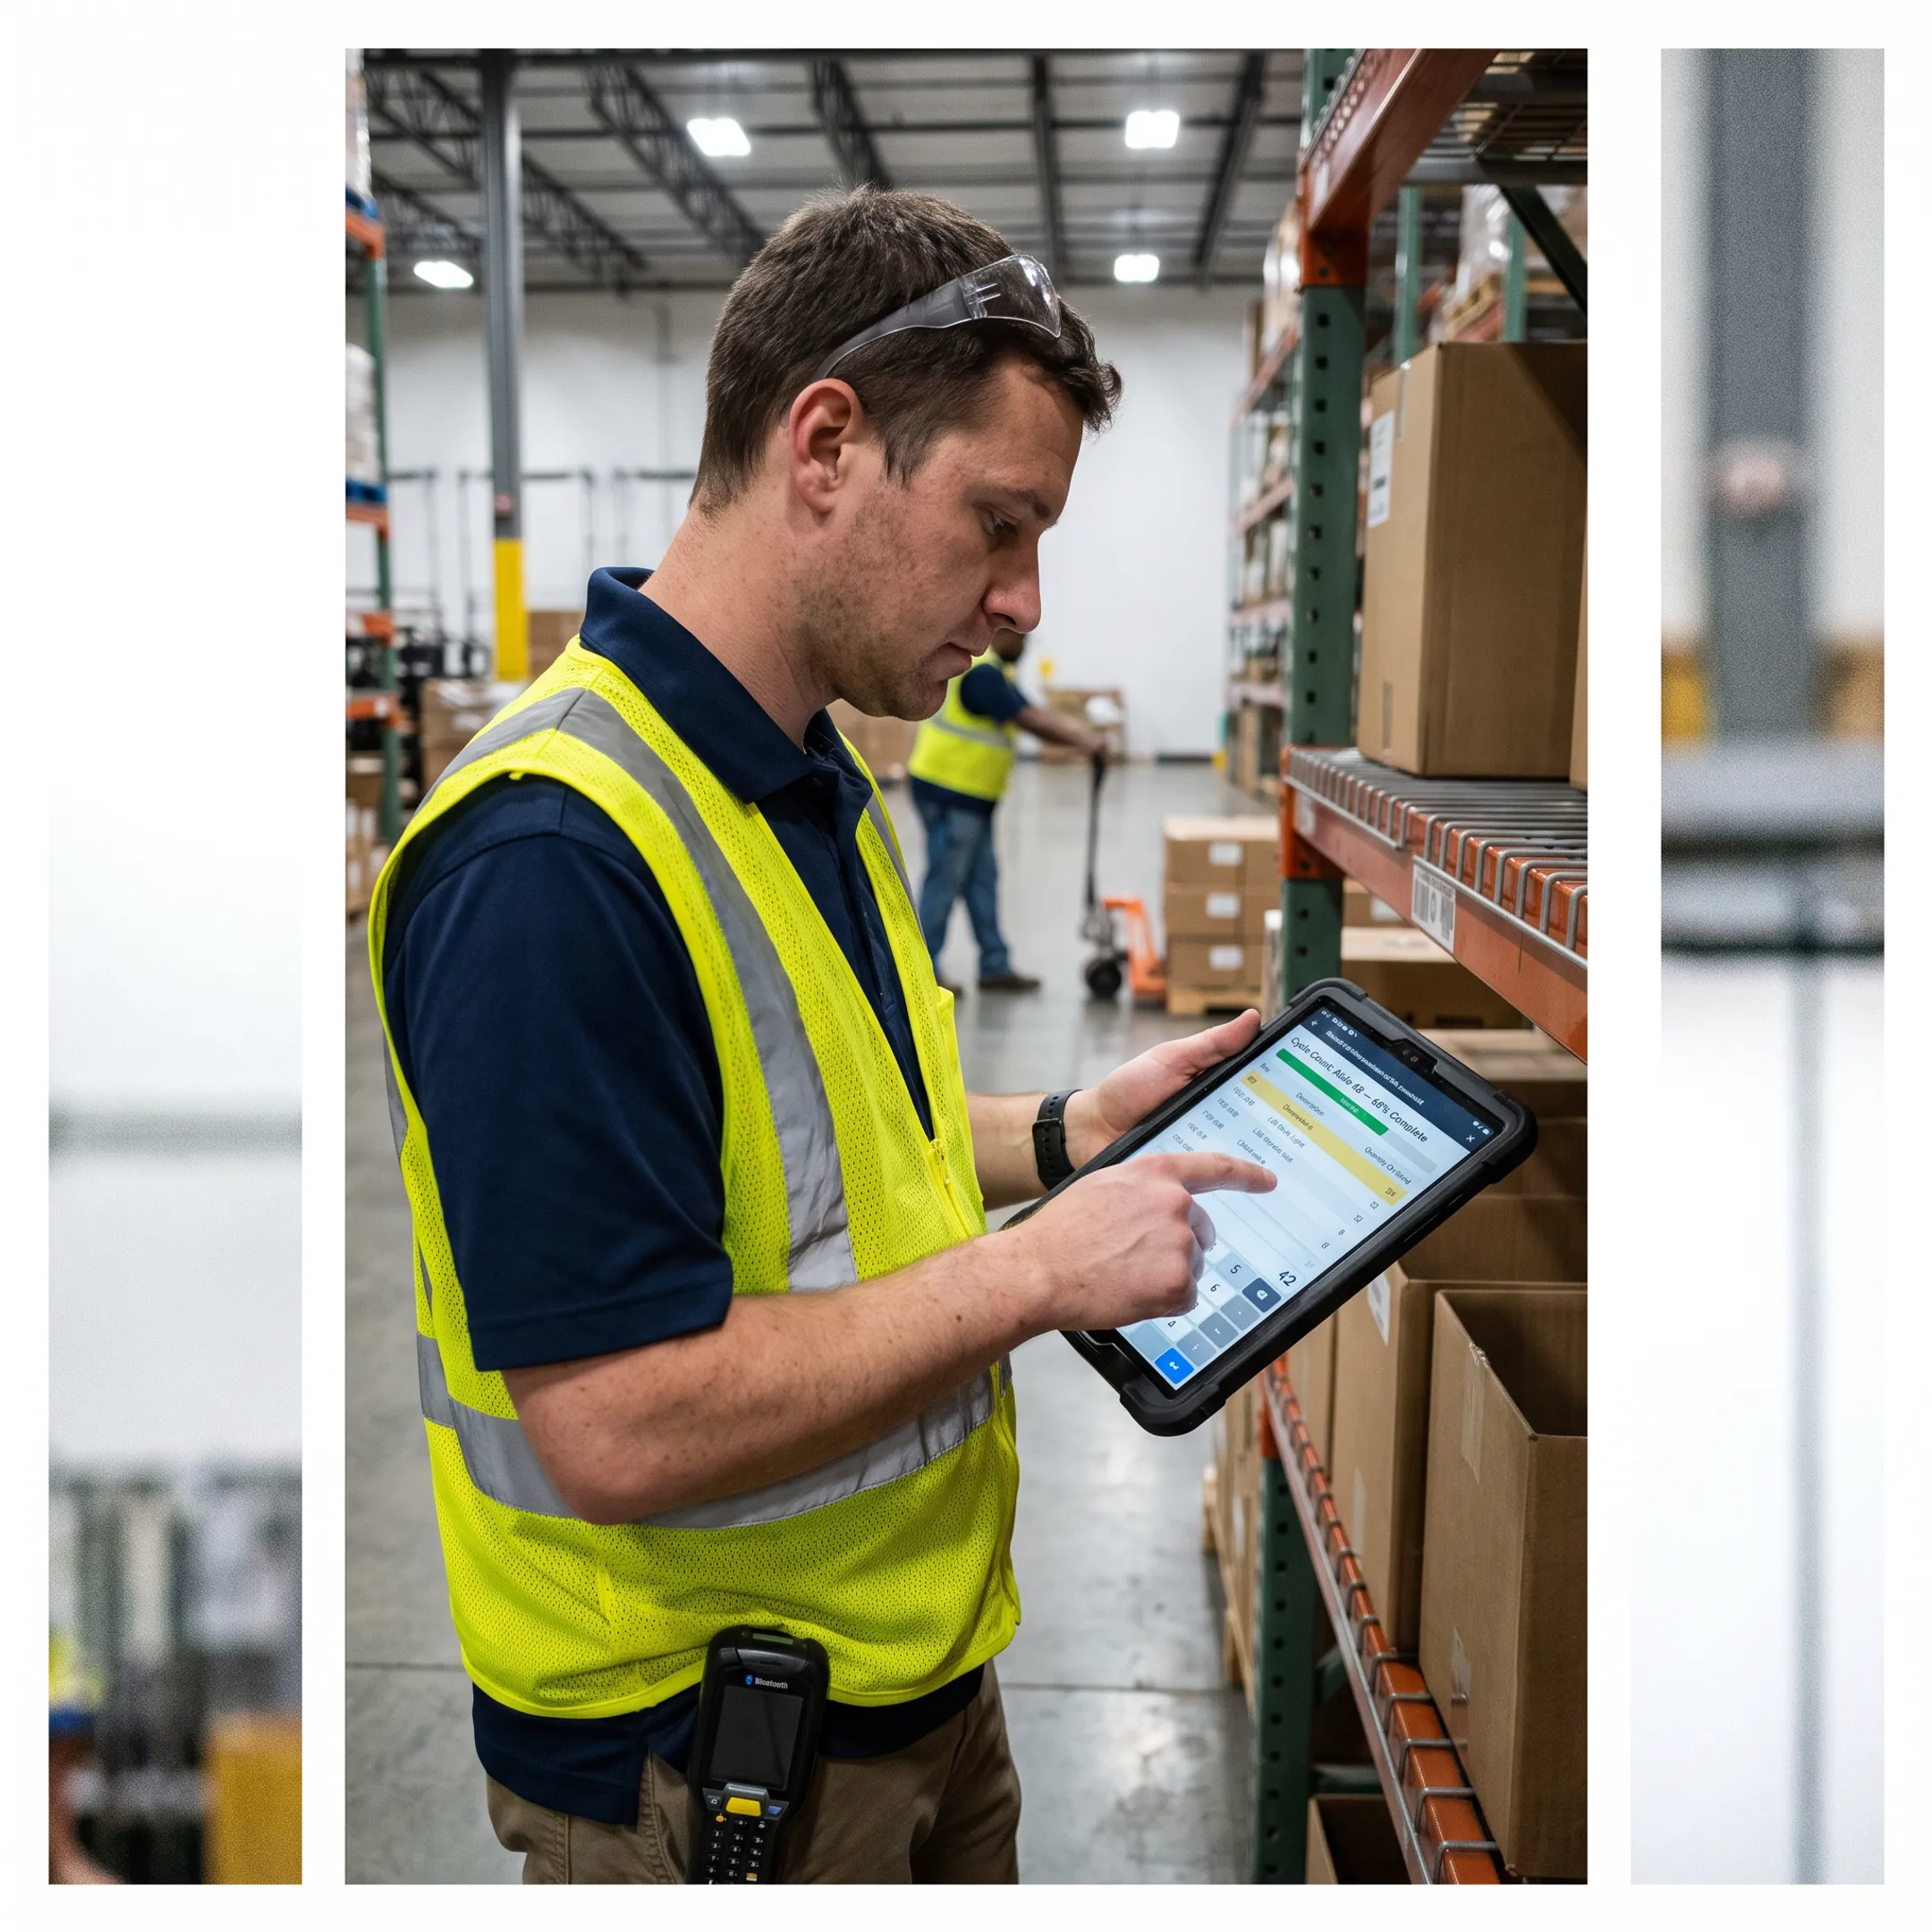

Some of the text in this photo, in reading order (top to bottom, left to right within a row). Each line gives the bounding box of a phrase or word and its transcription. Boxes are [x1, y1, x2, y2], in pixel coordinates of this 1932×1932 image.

[1389, 1111, 1428, 1142] Complete
[1278, 1271, 1296, 1286] 42
[1209, 1284, 1220, 1292] 6
